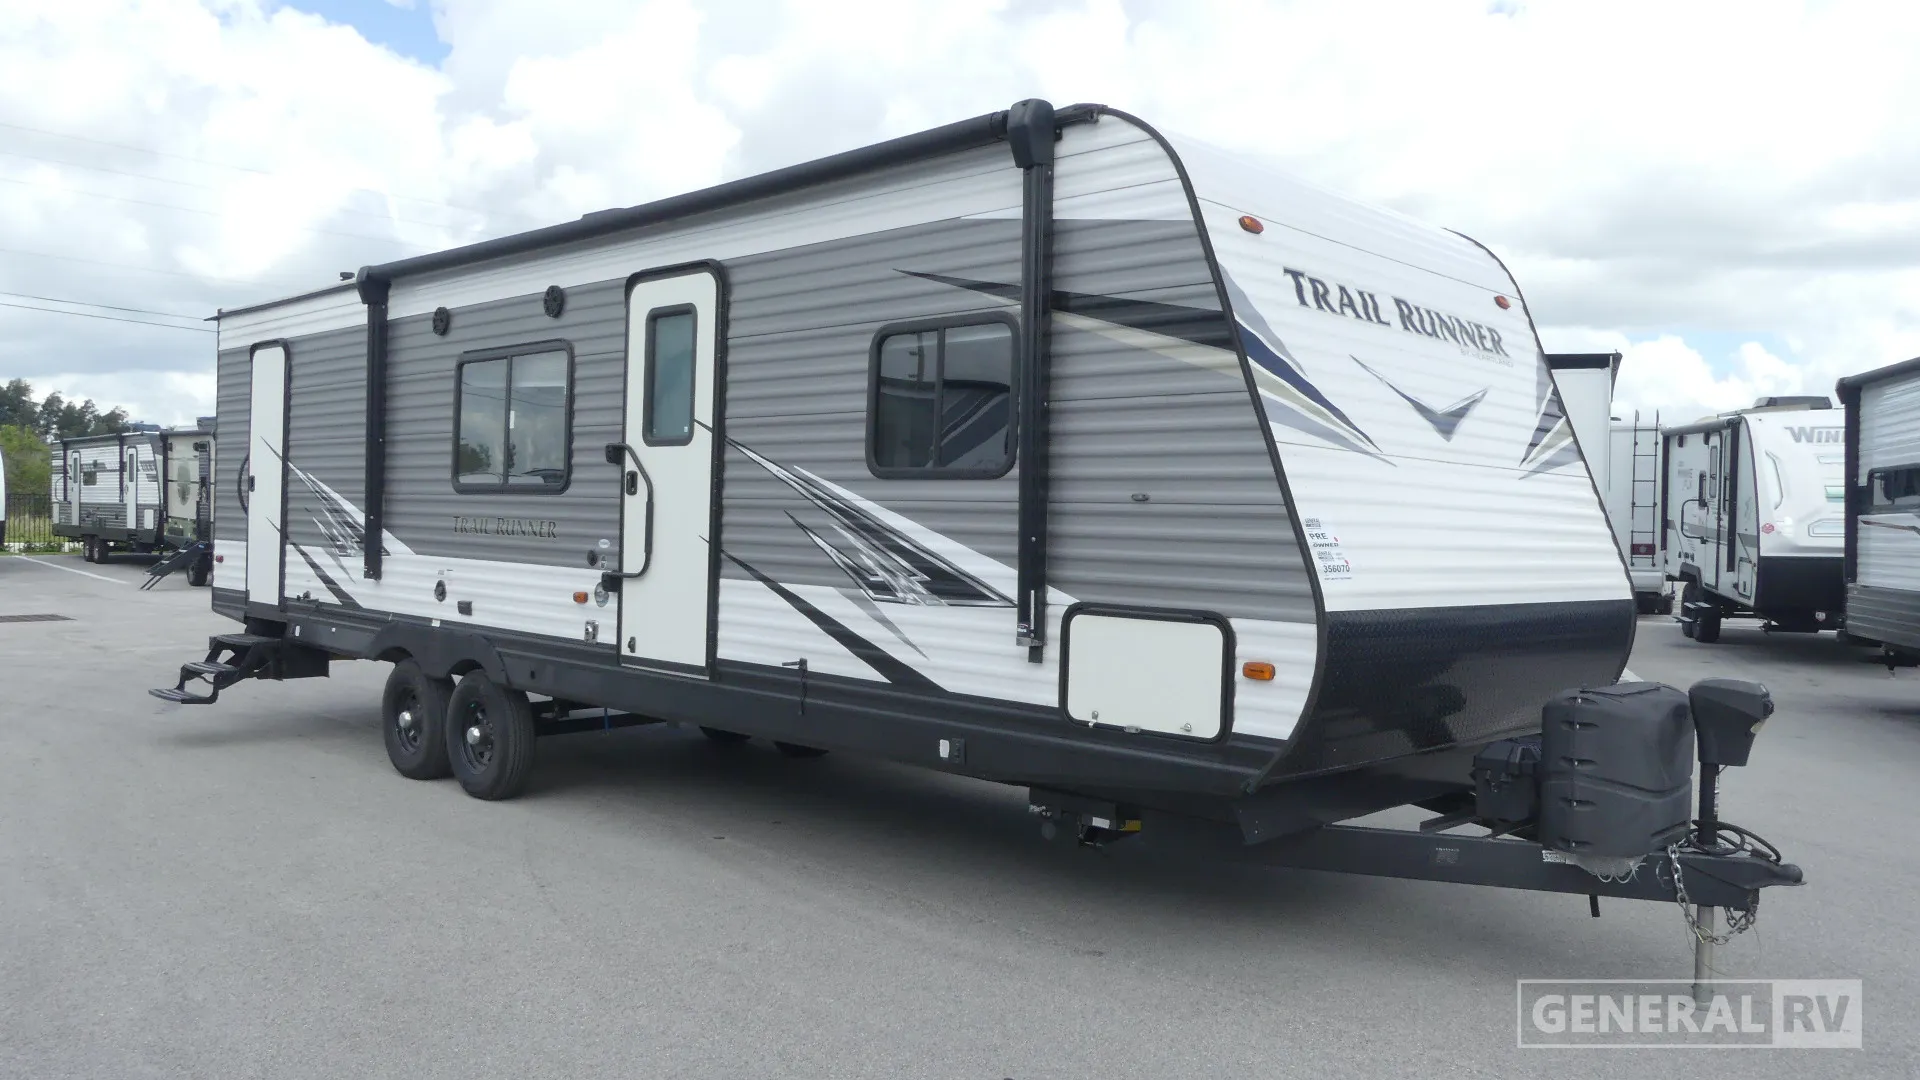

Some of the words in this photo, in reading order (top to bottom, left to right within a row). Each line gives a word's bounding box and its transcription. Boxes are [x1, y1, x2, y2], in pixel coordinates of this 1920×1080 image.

[1283, 266, 1391, 327] TRAIL
[1391, 296, 1510, 358] RUNNER
[1783, 426, 1845, 443] WIN
[453, 516, 491, 535] TRAIL
[496, 517, 557, 539] RUNNER
[1309, 532, 1328, 540] PRE
[1323, 564, 1350, 573] 356070
